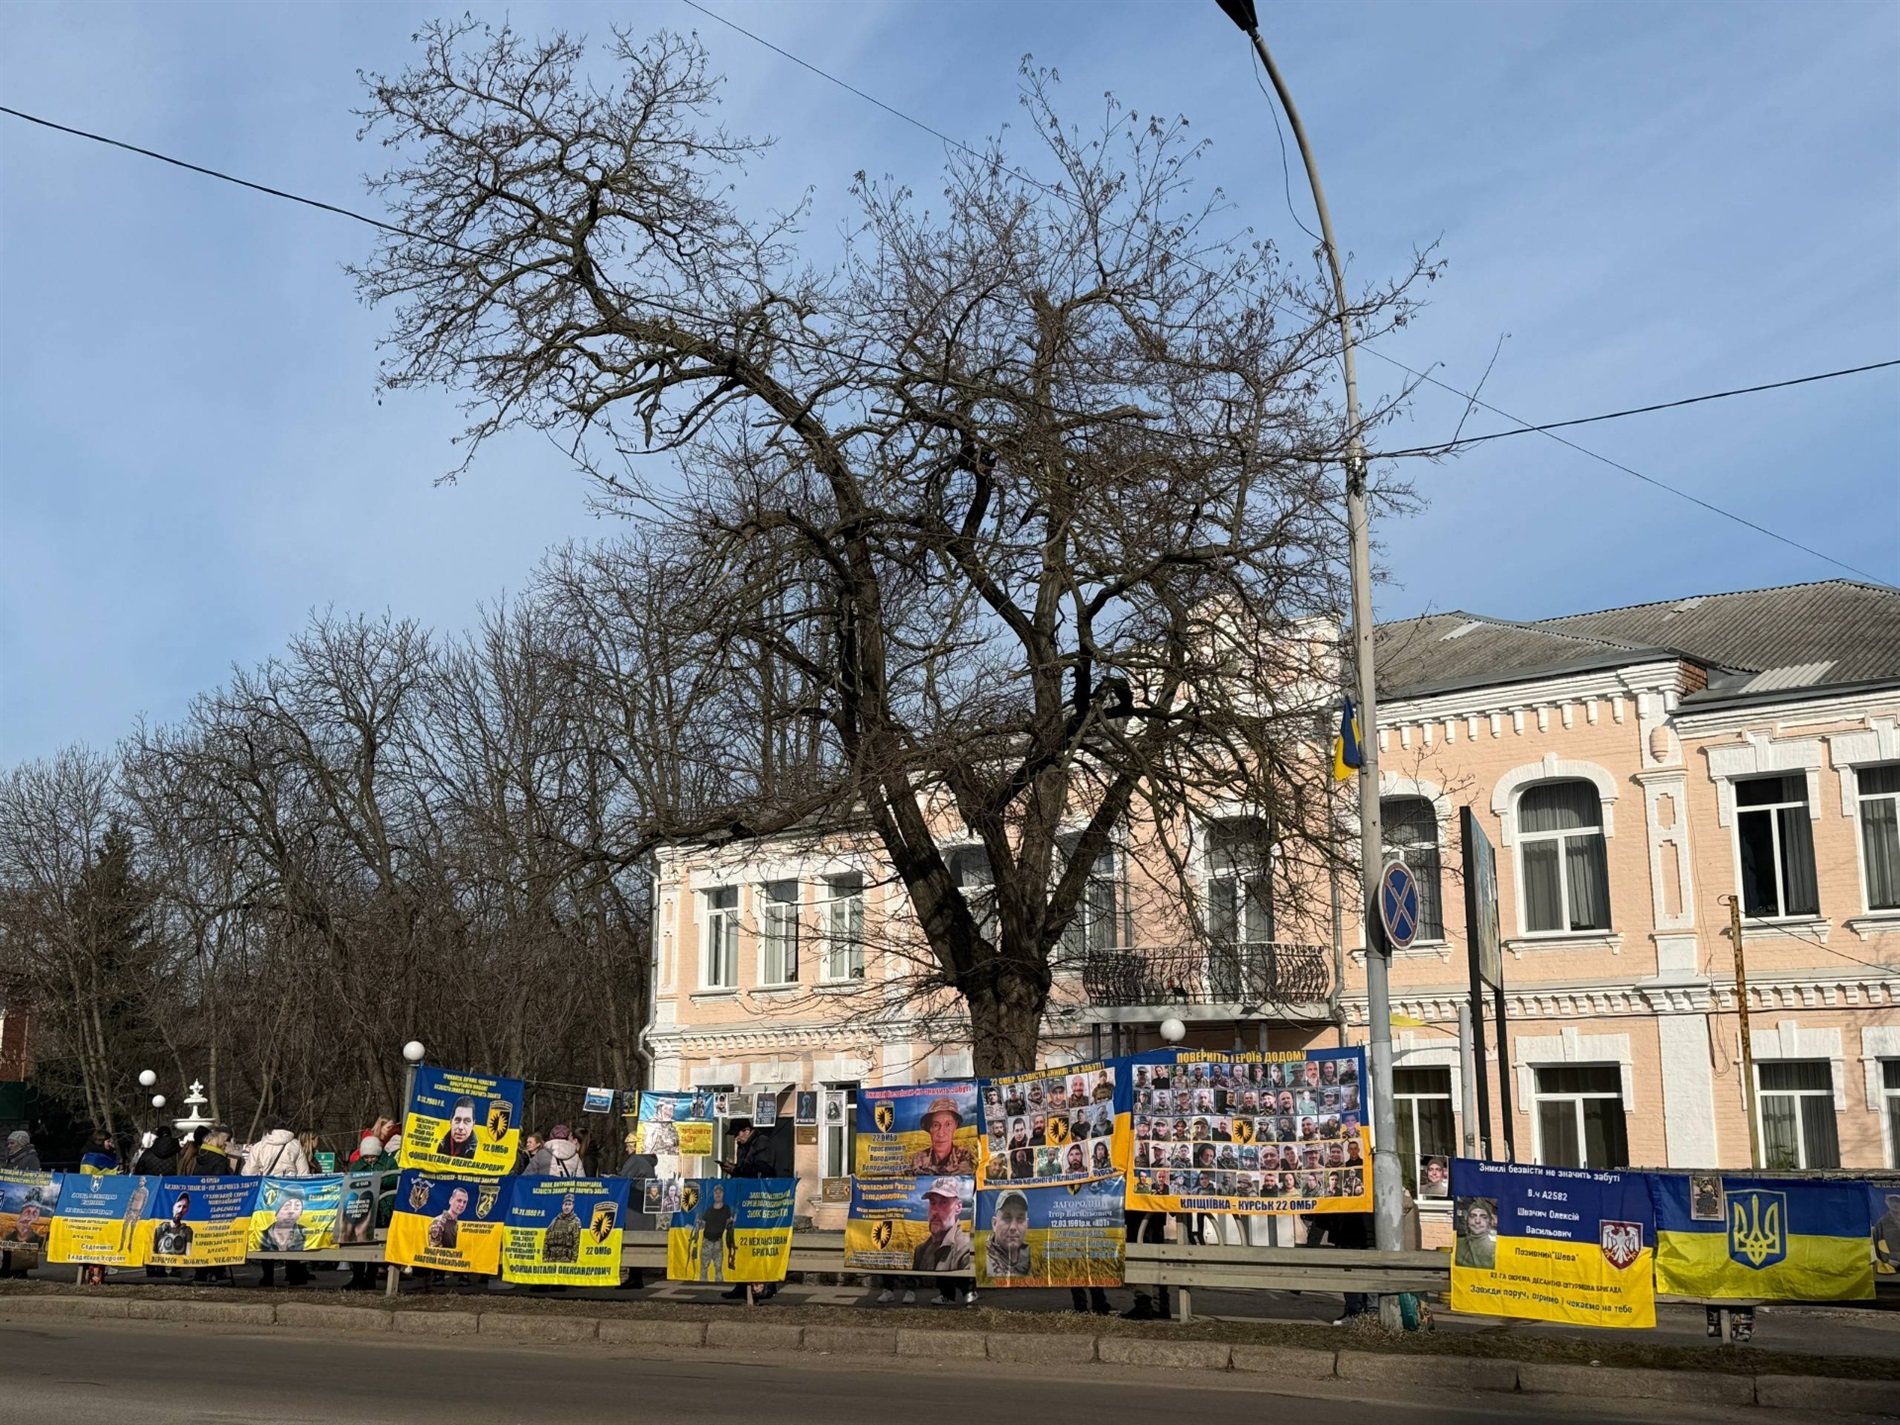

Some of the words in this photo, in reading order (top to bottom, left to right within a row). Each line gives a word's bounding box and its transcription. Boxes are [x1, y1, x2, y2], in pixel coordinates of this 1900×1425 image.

[1177, 1052, 1228, 1064] ПОВЕРНІТЬ
[1230, 1050, 1262, 1063] ГЕРОЇВ
[1264, 1049, 1307, 1063] ДОДОМУ
[872, 1134, 880, 1142] 22
[483, 1143, 490, 1152] 22
[1479, 1163, 1506, 1173] Зниклі
[1508, 1164, 1544, 1176] безвісти
[1558, 1170, 1592, 1180] значить
[1542, 1191, 1568, 1202] А2582
[1180, 1198, 1231, 1210] КЛІЩІЇВКА
[1238, 1200, 1274, 1211] КУРСЬК
[1276, 1200, 1288, 1211] 22
[1290, 1200, 1318, 1210] ОМБР
[1048, 1210, 1064, 1218] Ігор
[1066, 1210, 1112, 1218] Васильович
[1517, 1208, 1548, 1218] Швачич
[1549, 1210, 1580, 1222] Олексій
[1525, 1226, 1572, 1238] Васильович
[740, 1237, 748, 1246] 22
[586, 1246, 594, 1255] 22
[1508, 1274, 1530, 1282] ОКРЕМА
[1596, 1285, 1622, 1294] БРИГАДА
[1470, 1284, 1502, 1296] Завжди
[1614, 1304, 1632, 1314] тебе
